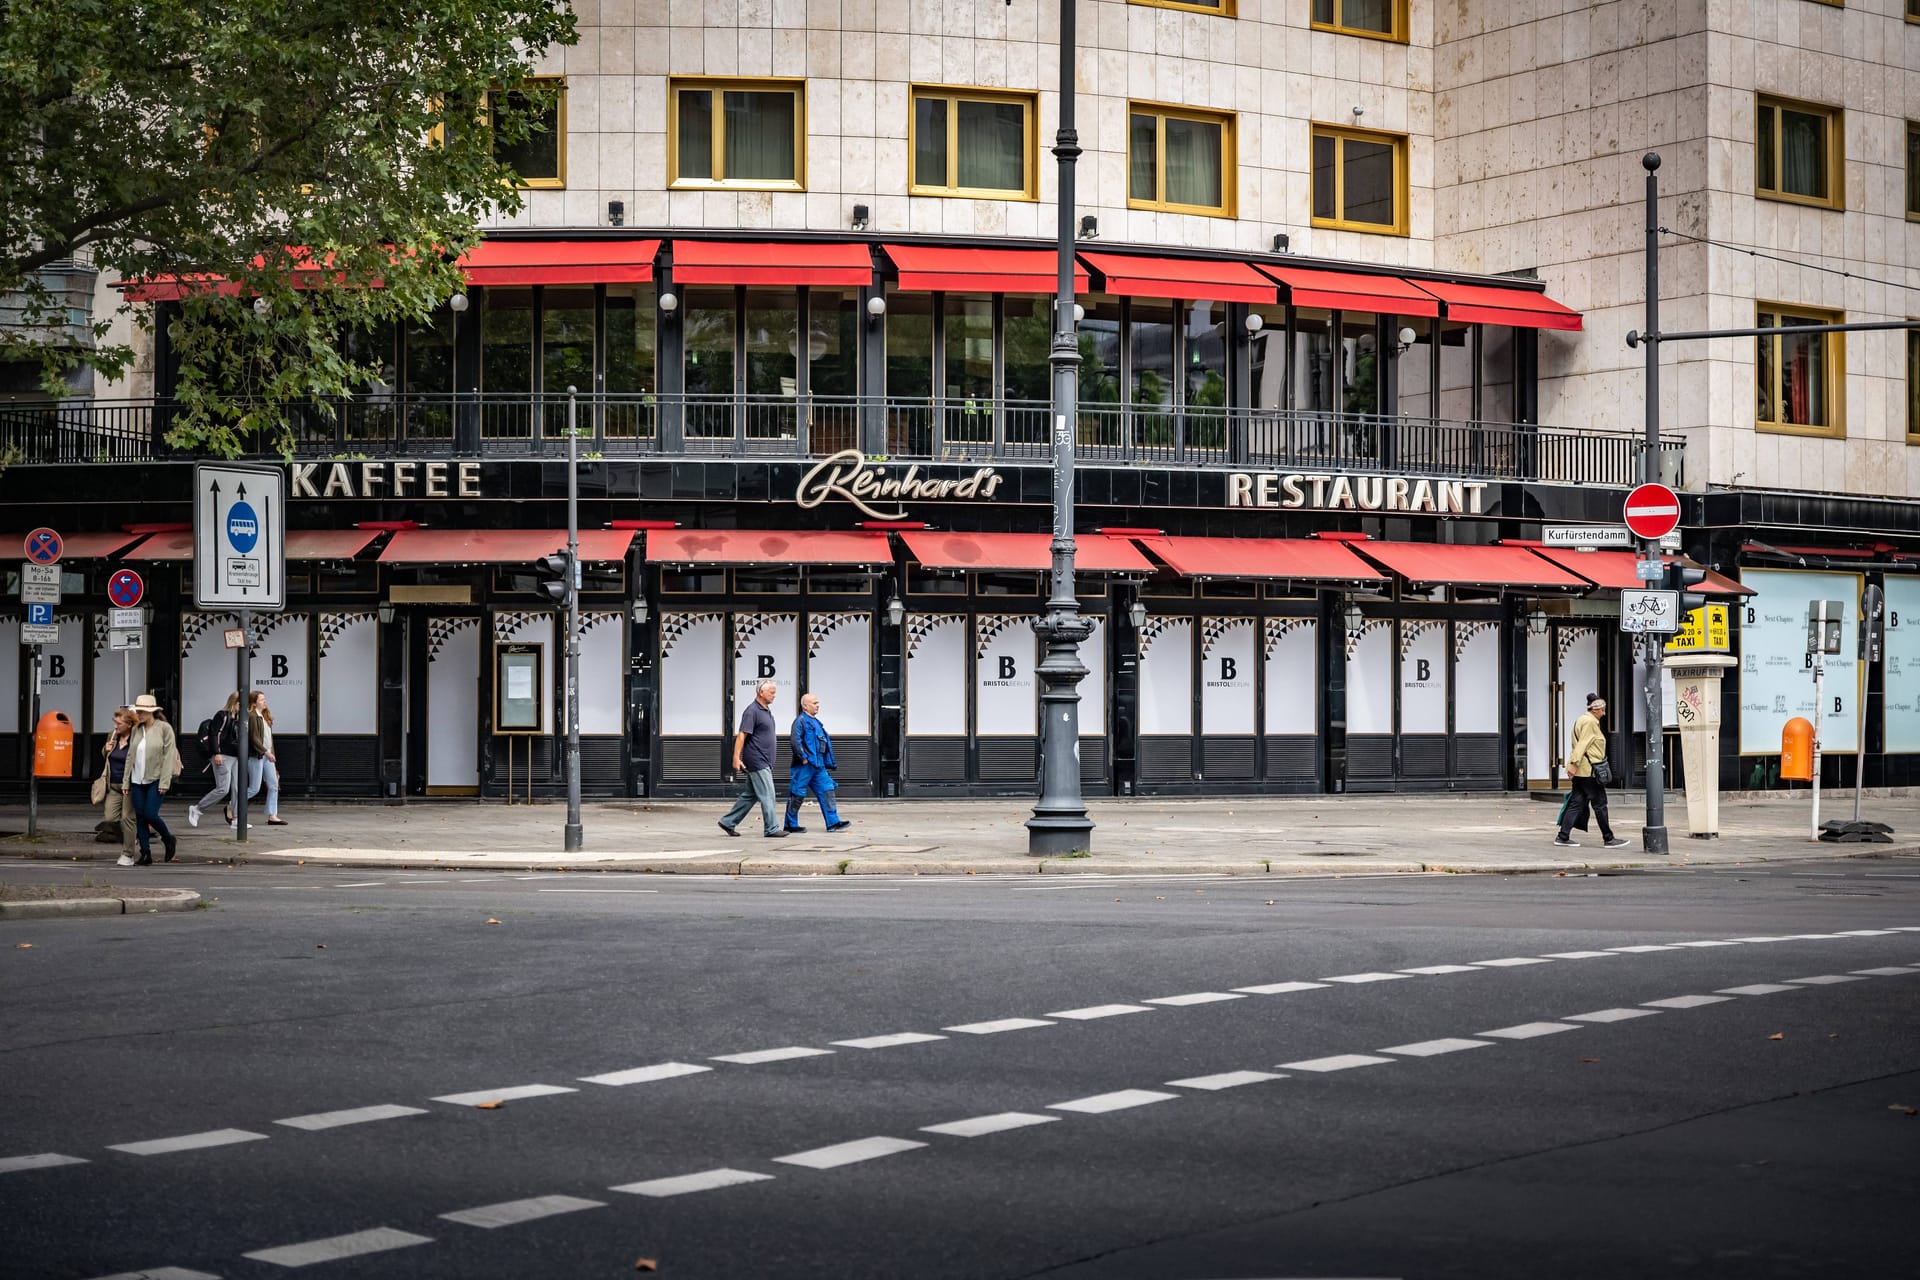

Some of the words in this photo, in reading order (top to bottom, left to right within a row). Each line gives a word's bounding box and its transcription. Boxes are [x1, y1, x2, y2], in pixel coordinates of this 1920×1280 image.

[291, 463, 481, 497] KAFFEE
[796, 449, 1003, 520] Reinhard's
[1229, 473, 1488, 514] RESTAURANT
[1548, 530, 1626, 540] Kurfürstendamm
[33, 605, 45, 622] P
[1747, 607, 1756, 624] B
[1890, 611, 1898, 627] B
[1675, 637, 1695, 647] TAXI
[1713, 636, 1723, 646] TAXI
[49, 654, 66, 678] B
[271, 654, 289, 678] B
[757, 654, 776, 678] B
[998, 655, 1017, 679] B
[1221, 657, 1237, 680] B
[1416, 659, 1431, 681] B
[1805, 653, 1813, 668] B
[1671, 668, 1706, 677] TAXIRUF
[1834, 696, 1842, 713] B
